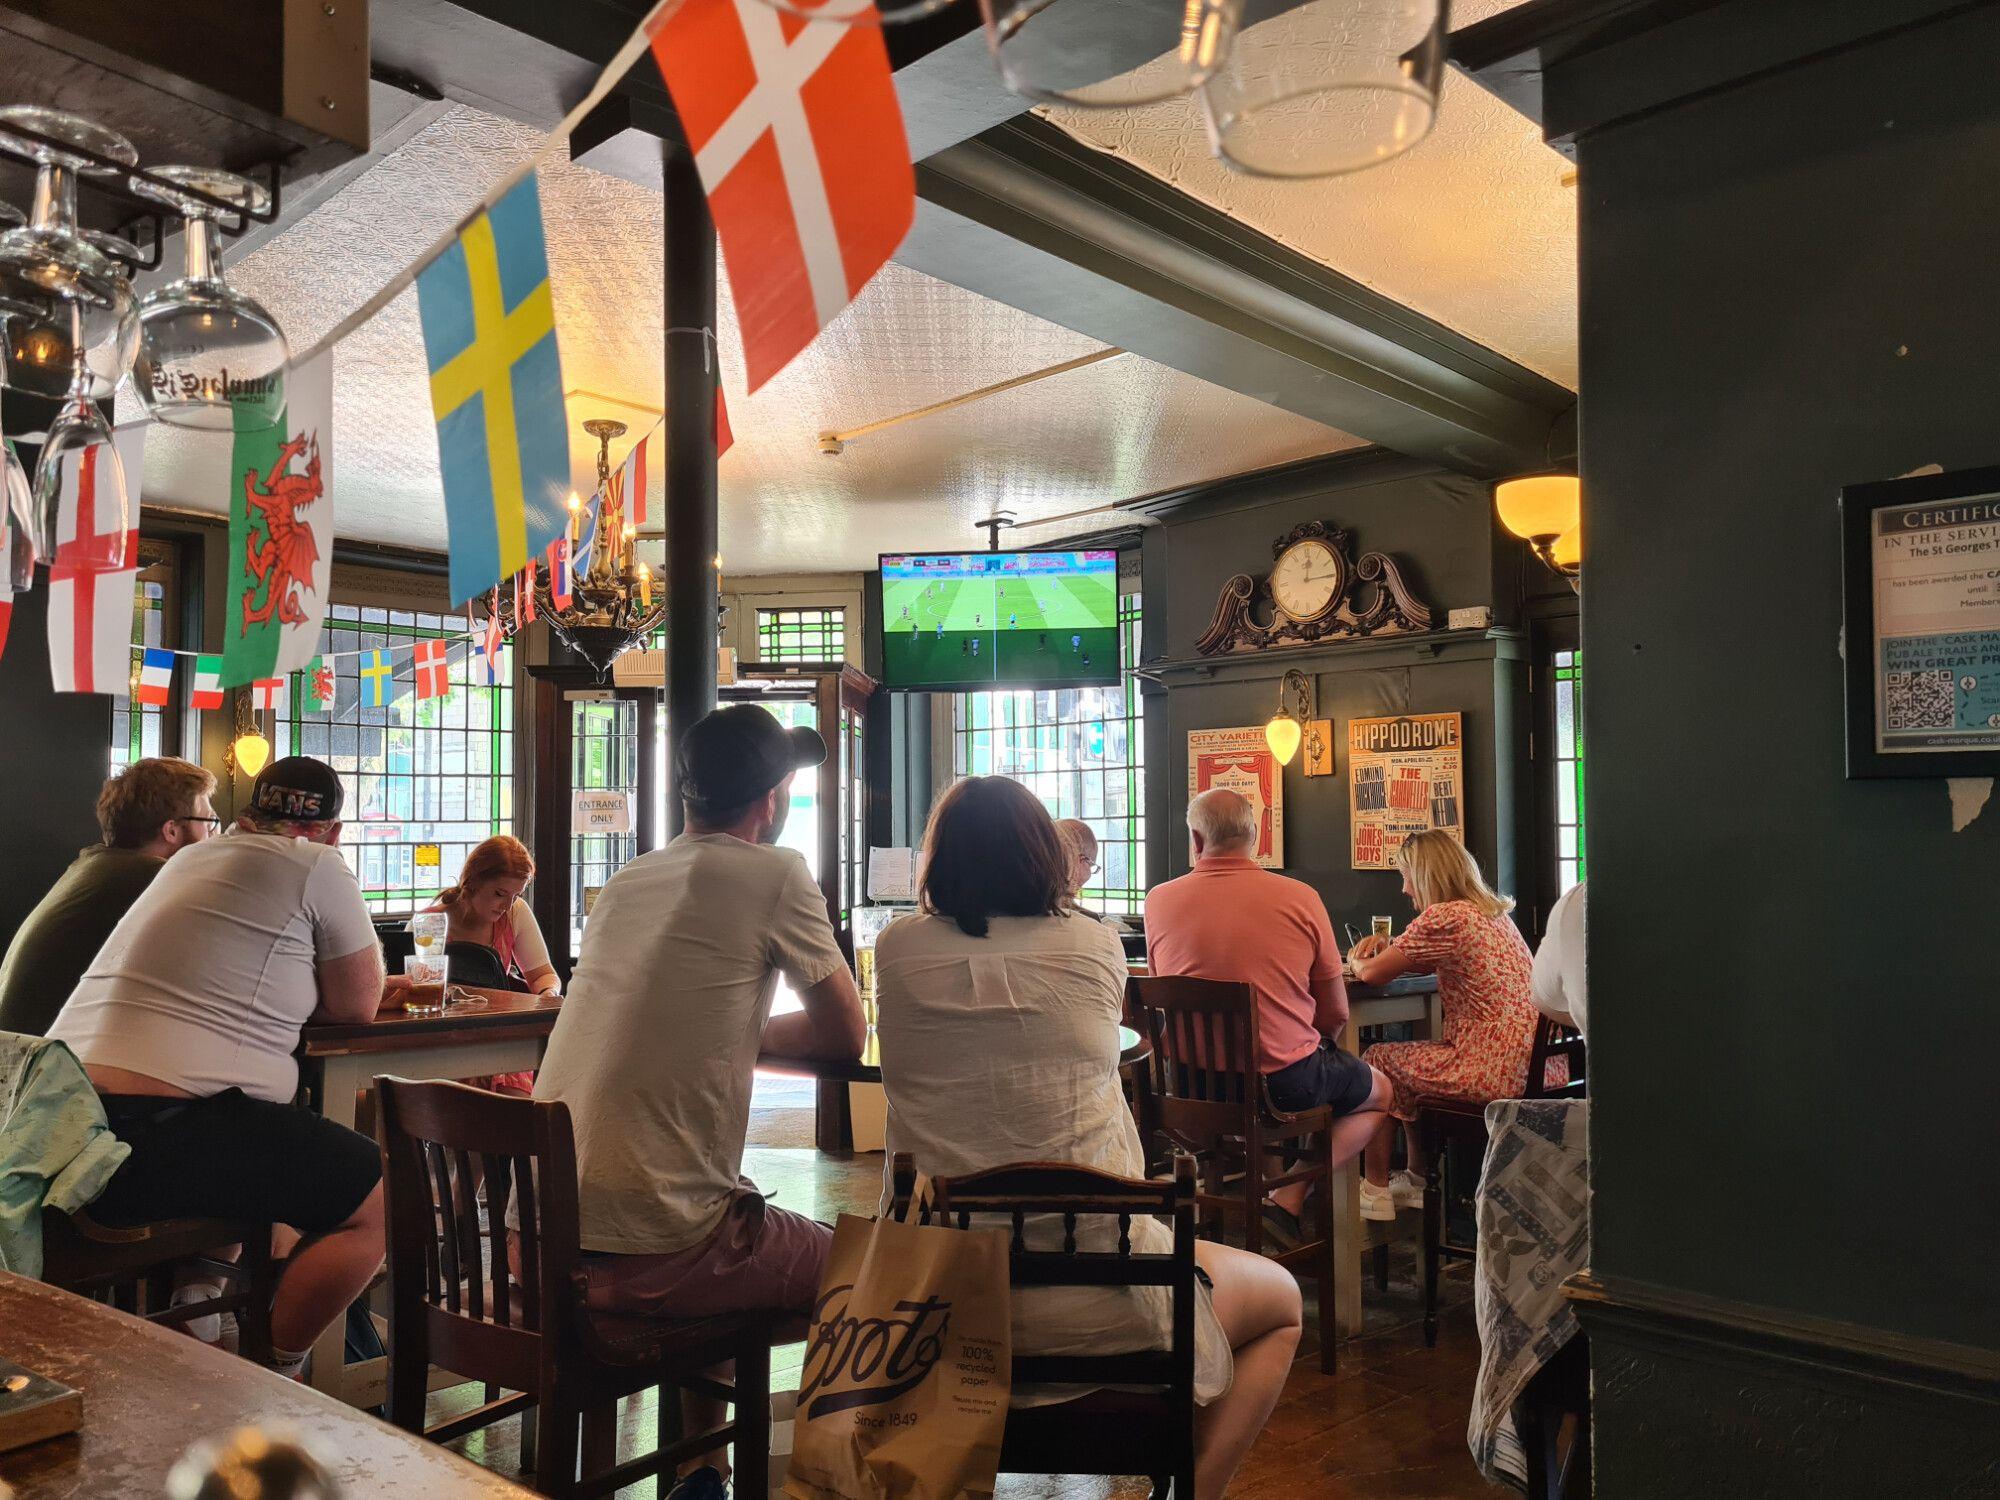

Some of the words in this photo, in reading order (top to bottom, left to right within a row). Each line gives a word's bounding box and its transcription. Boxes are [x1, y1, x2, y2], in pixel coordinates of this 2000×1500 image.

[1884, 537, 1901, 549] IN
[1908, 532, 1942, 546] THE
[1910, 547, 1929, 558] The
[1931, 545, 1944, 555] St
[1945, 540, 1991, 554] Georges
[1892, 579, 1907, 587] has
[1909, 576, 1930, 586] been
[1931, 573, 1967, 583] awarded
[1970, 571, 1984, 580] the
[1886, 639, 1912, 650] JOIN
[1916, 638, 1938, 647] THE
[1981, 631, 2000, 642] MA
[1887, 649, 1909, 659] PUB
[1912, 648, 1935, 657] ALE
[1935, 645, 1977, 656] TRAILS
[1888, 659, 1920, 670] WIN
[1925, 656, 1977, 668] GREAT
[1982, 654, 2000, 664] PR
[1190, 734, 1216, 743] CITY
[1353, 718, 1456, 750] HIPPODROME
[1927, 735, 2000, 745] cask-marque.co.u
[1354, 766, 1384, 783] EDMUND
[1400, 767, 1422, 779] THE
[1433, 780, 1453, 797] BERT
[259, 782, 324, 816] VANS
[578, 799, 624, 810] ENTRANCE
[590, 814, 614, 823] ONLY
[1356, 828, 1383, 847] JONES
[1357, 847, 1381, 862] BOYS
[797, 1284, 952, 1421] Boots
[962, 1345, 994, 1361] 100%
[956, 1362, 996, 1375] recycled
[961, 1376, 989, 1387] paper
[854, 1411, 884, 1428] Since
[889, 1412, 917, 1426] 1849
